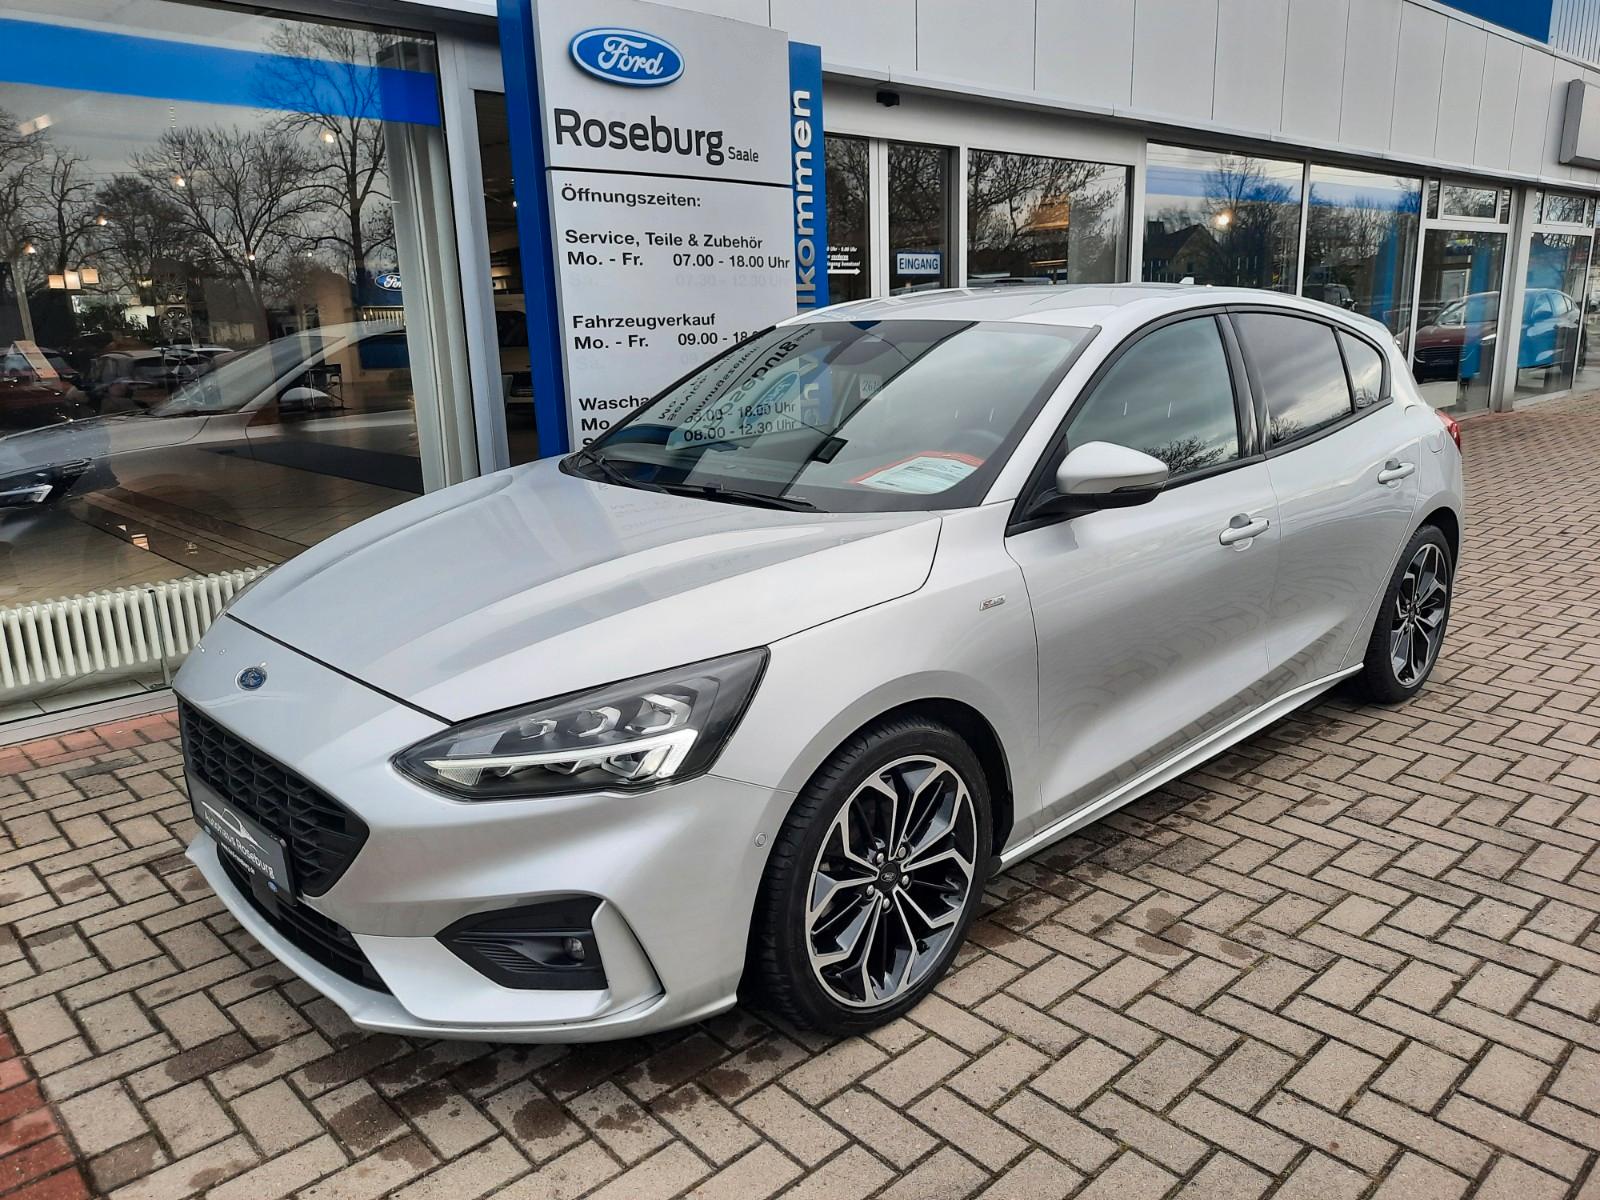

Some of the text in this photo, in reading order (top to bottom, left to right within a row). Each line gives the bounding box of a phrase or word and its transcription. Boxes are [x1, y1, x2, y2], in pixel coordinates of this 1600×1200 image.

[553, 107, 759, 166] Roseburg Saale
[561, 183, 701, 208] Öffnungszeiten:
[793, 90, 817, 315] lkommen
[565, 229, 763, 249] Service, Teile & Zubehör
[567, 251, 603, 266] Mo.
[622, 252, 644, 266] Fr.
[673, 253, 714, 267] 07.00
[729, 255, 764, 268] 18.00
[768, 256, 790, 269] Uhr
[899, 257, 939, 270] EINGANG
[573, 313, 716, 330] Fahrzeugverkauf
[574, 336, 609, 349] Mo.
[628, 334, 649, 347] Fr.
[678, 333, 718, 345] 09.00
[732, 330, 759, 345] 18
[775, 401, 796, 414] Uhr
[739, 421, 773, 436] 12.30
